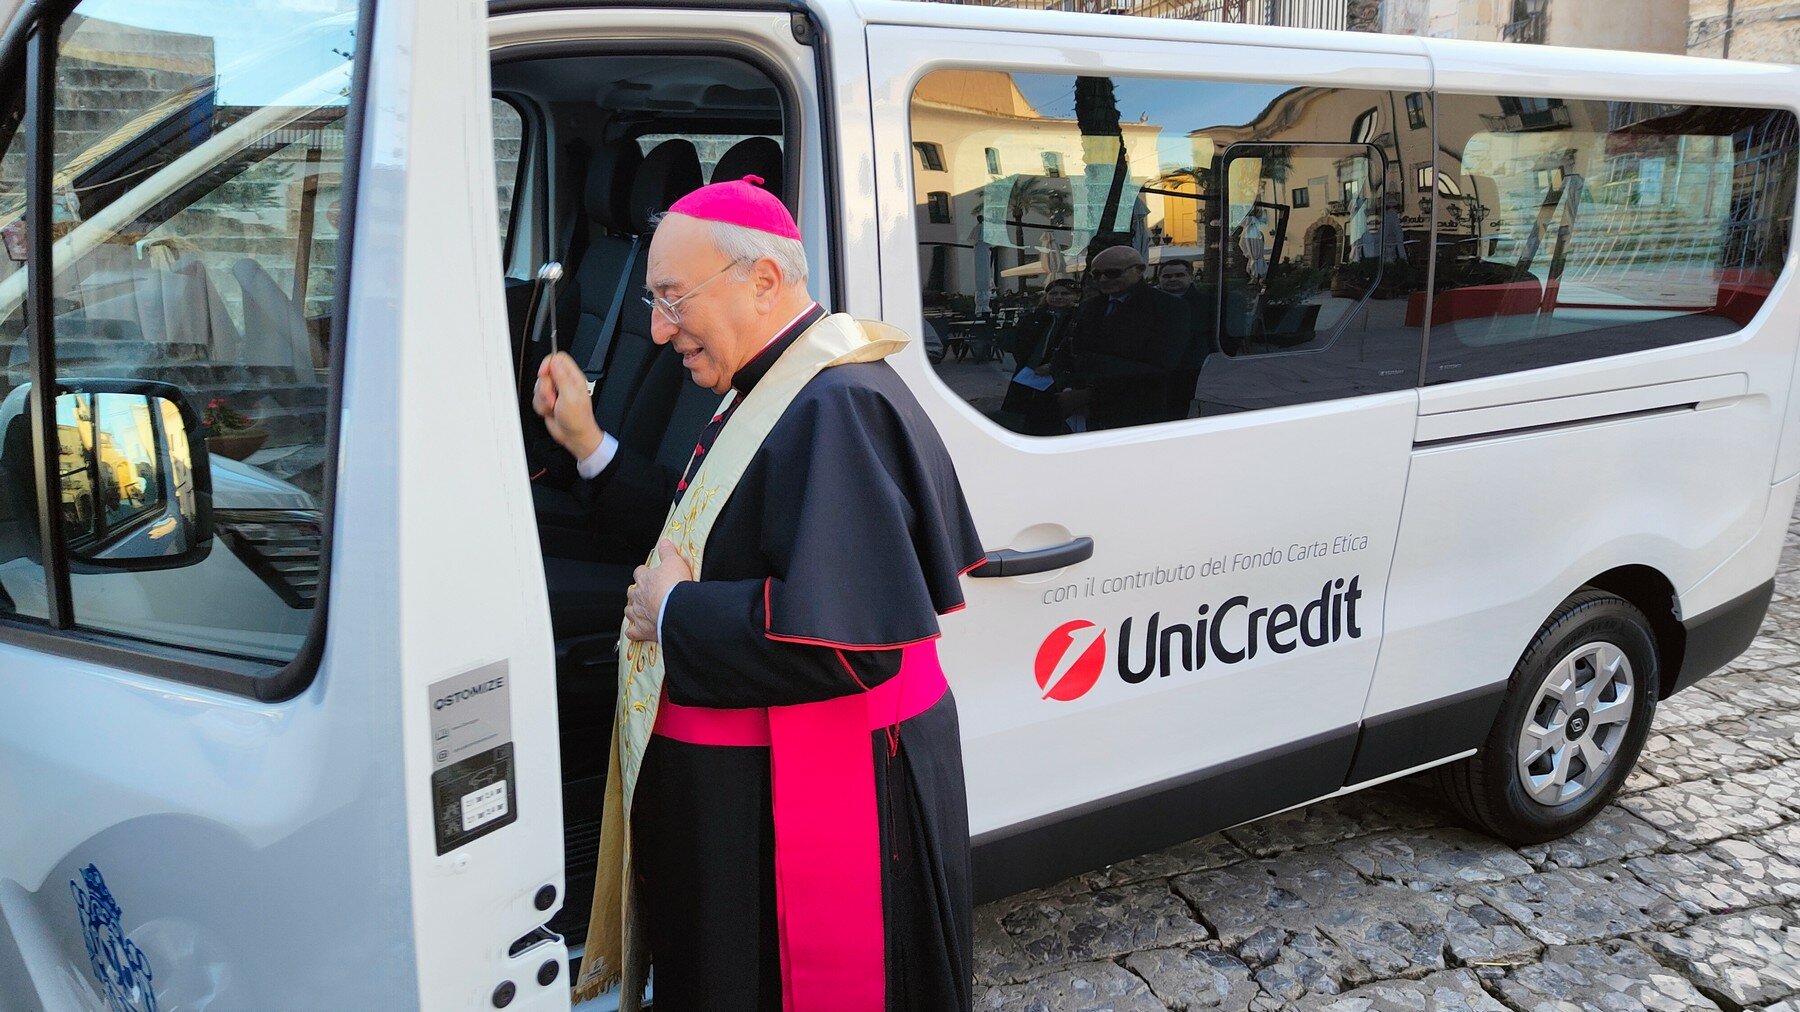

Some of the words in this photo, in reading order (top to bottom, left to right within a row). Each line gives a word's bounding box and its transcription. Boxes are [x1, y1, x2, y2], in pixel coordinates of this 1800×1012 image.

[1043, 584, 1077, 605] con
[1085, 576, 1096, 598] il
[1102, 563, 1195, 595] contributo
[1201, 555, 1227, 577] del
[1232, 547, 1283, 572] Fondo
[1287, 541, 1328, 562] Carta
[1332, 533, 1368, 555] Etica
[1117, 574, 1363, 684] UniCredit
